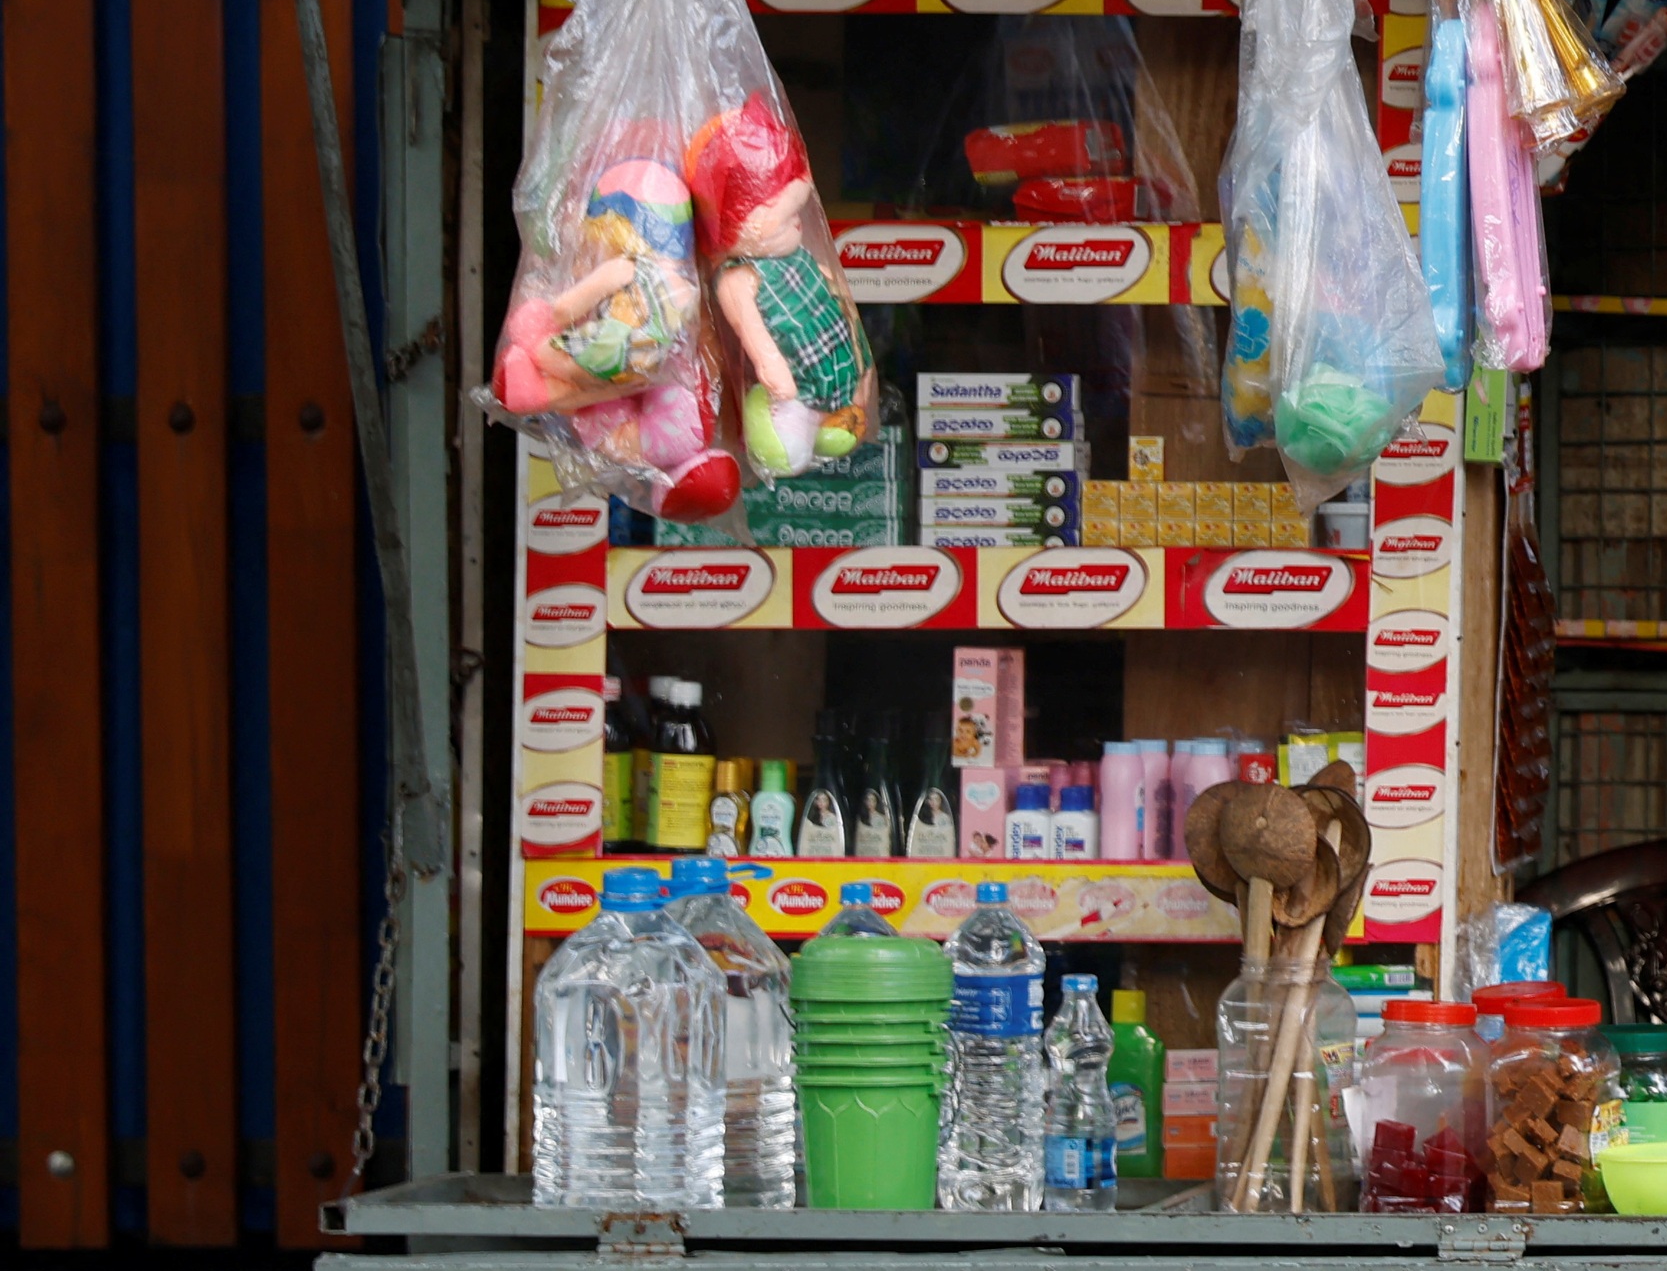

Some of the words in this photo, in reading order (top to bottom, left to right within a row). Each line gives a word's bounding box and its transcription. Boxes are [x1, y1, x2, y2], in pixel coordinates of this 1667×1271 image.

[845, 241, 933, 262] Maliban
[1034, 241, 1123, 263] Maliban
[931, 384, 1001, 398] Sudantha
[651, 567, 738, 587] Maliban
[840, 567, 928, 587] Maliban
[1028, 568, 1118, 587] Maliban
[1233, 567, 1320, 587] Maliban
[1224, 601, 1268, 614] Inspiring
[1380, 632, 1437, 645] Maliban
[959, 657, 991, 668] panda
[1380, 693, 1434, 705] Maliban
[1377, 787, 1432, 800] Maliban
[1376, 881, 1432, 894] Maliban
[547, 892, 593, 907] Munchee
[772, 892, 824, 907] Munchee
